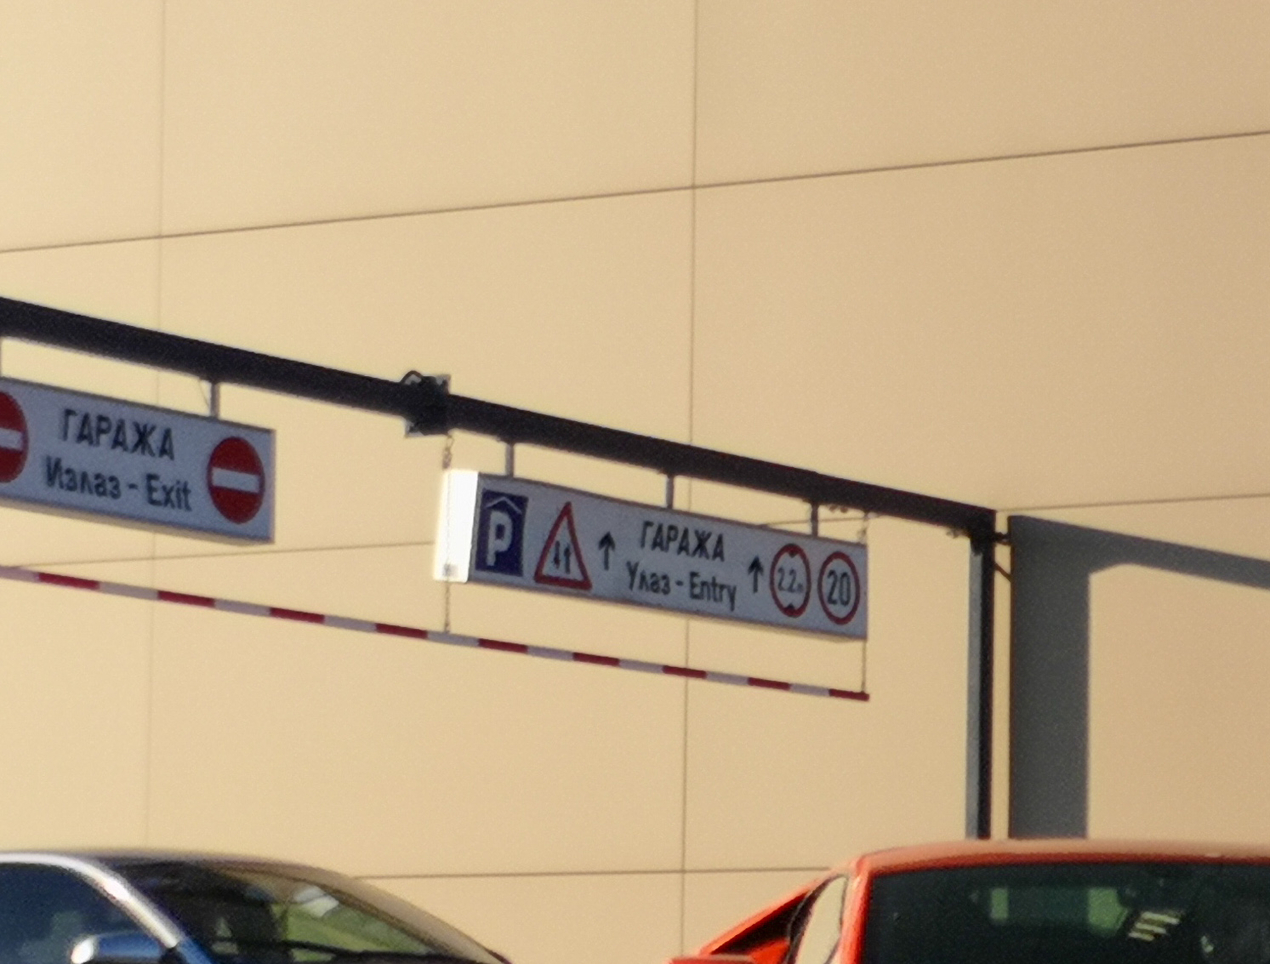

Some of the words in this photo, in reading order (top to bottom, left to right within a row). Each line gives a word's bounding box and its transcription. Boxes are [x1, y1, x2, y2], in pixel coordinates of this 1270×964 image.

[62, 409, 174, 460] ГАРАЖА
[45, 456, 122, 499] Излаз
[146, 473, 192, 510] Exit
[486, 510, 512, 566] P
[640, 520, 725, 562] ГАРАЖА
[626, 560, 671, 596] Улаз
[689, 571, 737, 612] Entry
[827, 569, 852, 607] 20
